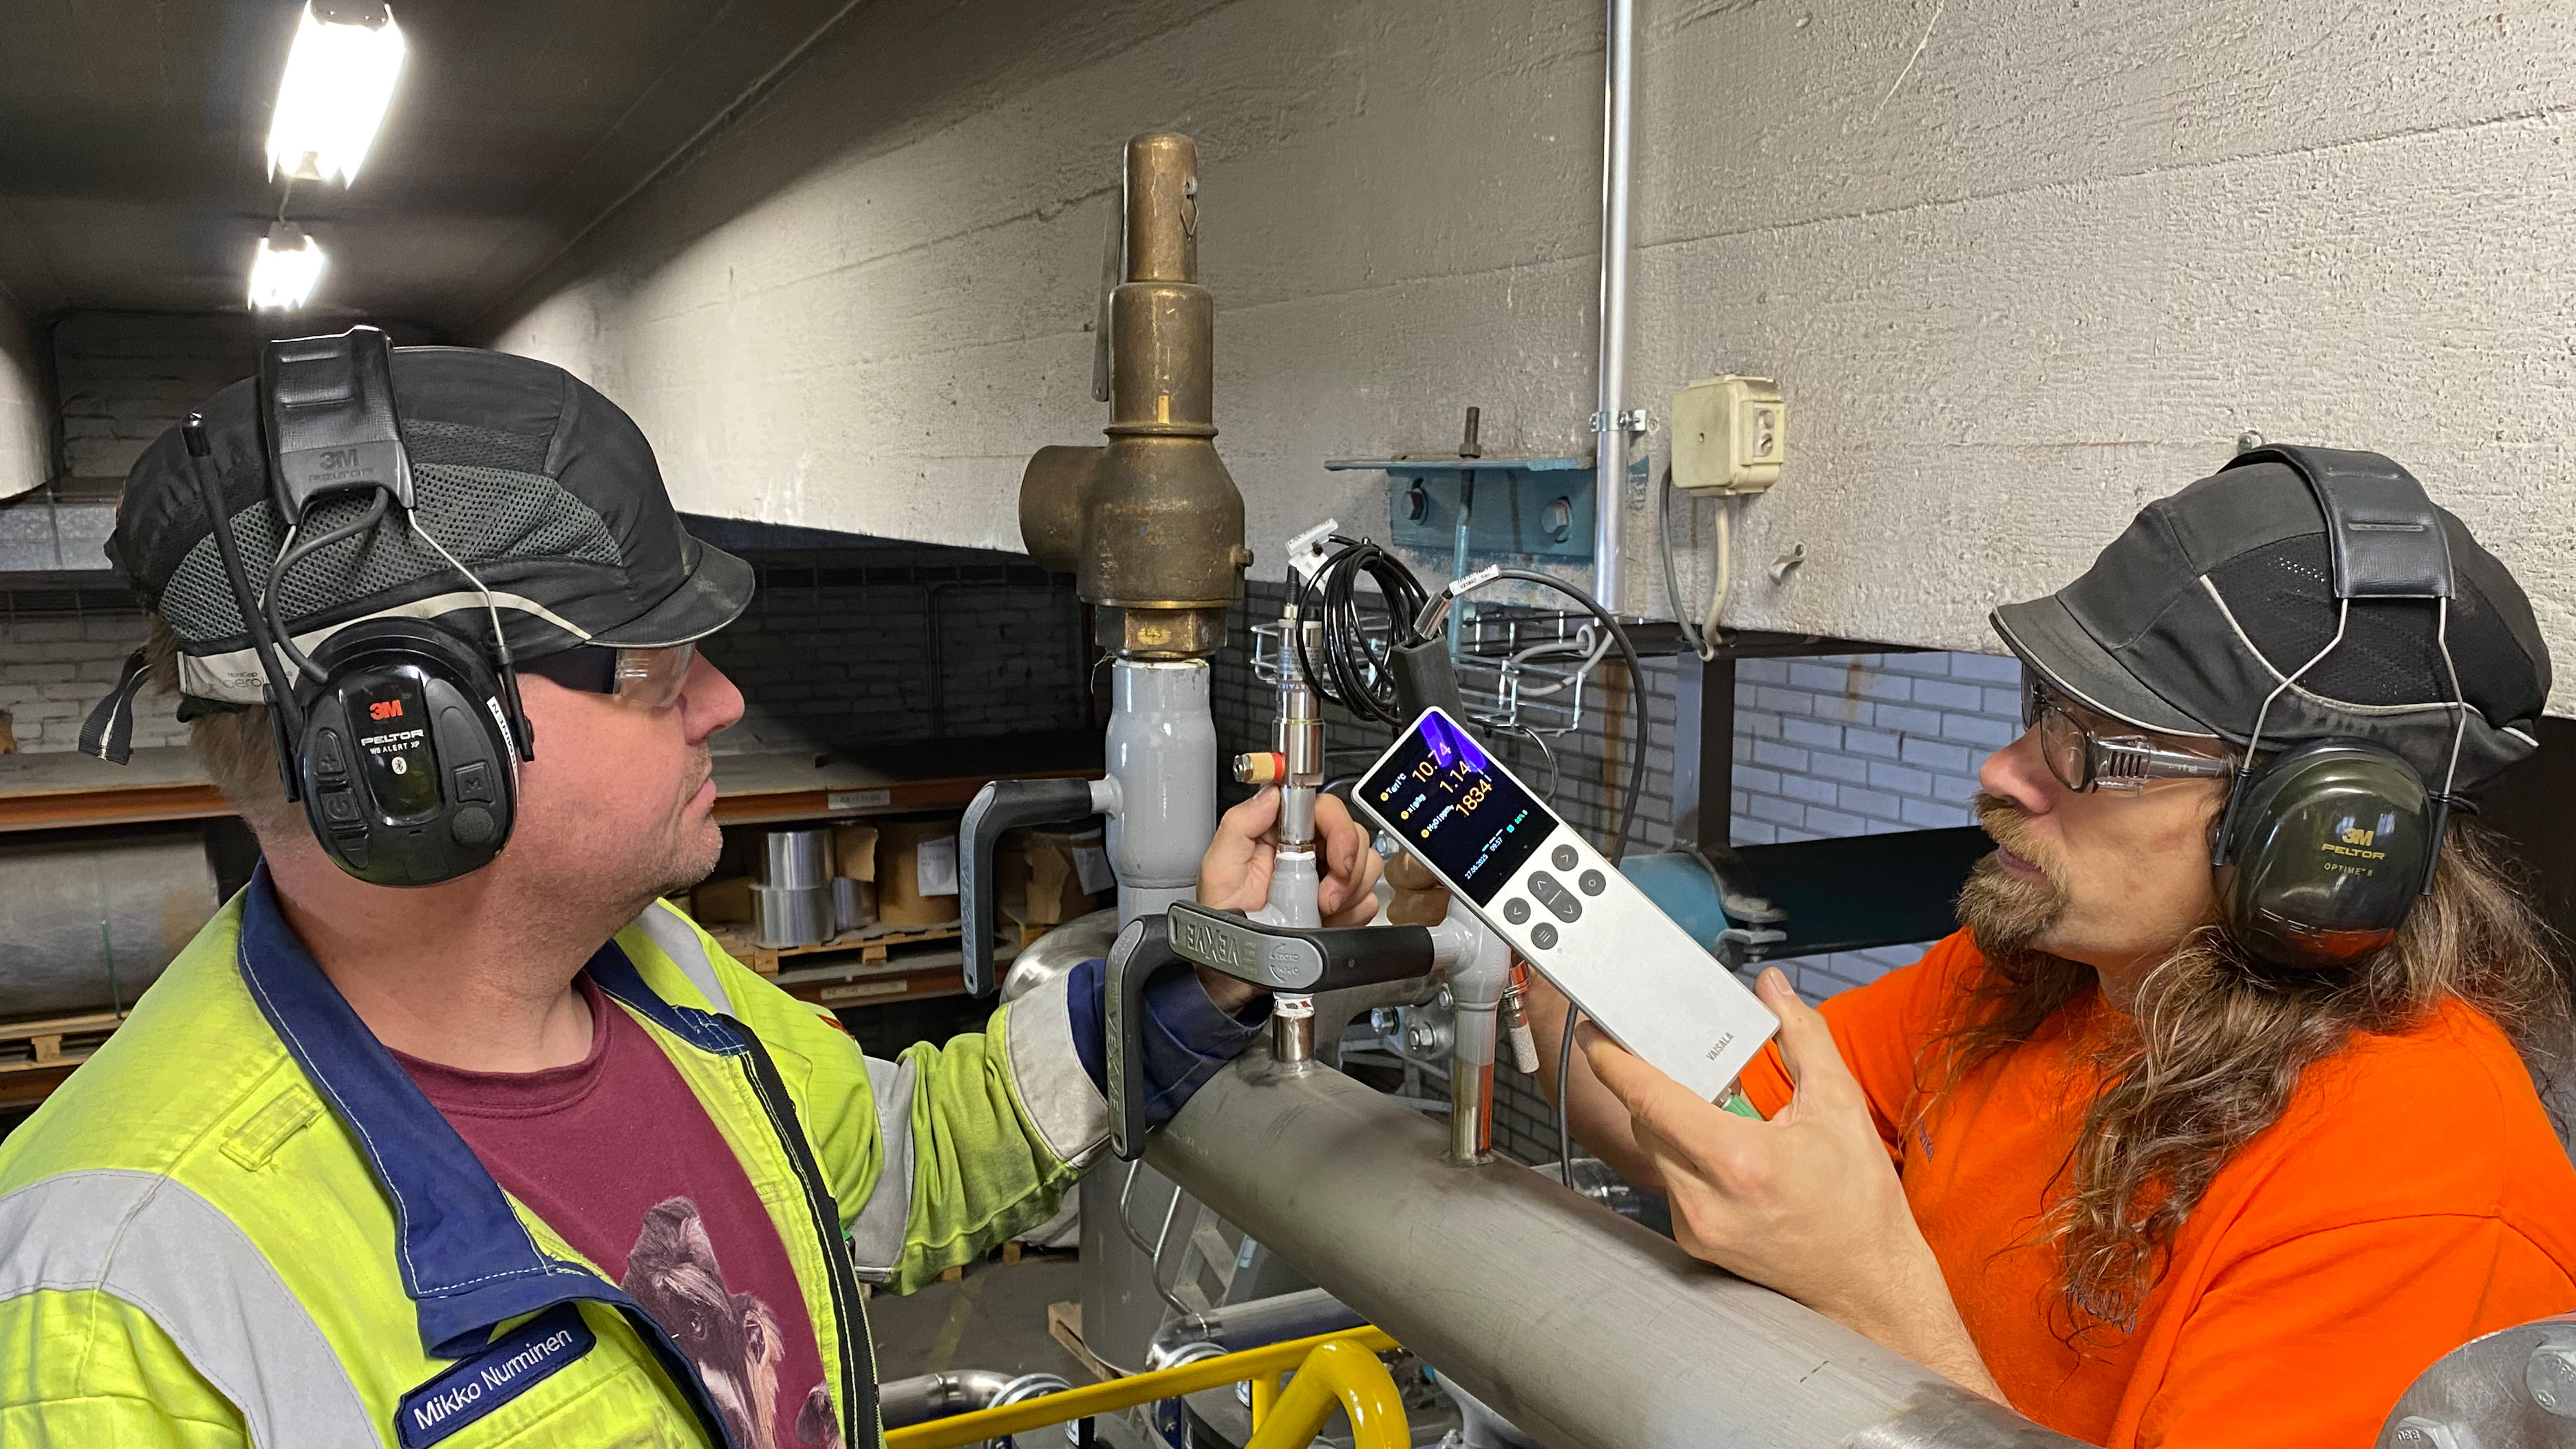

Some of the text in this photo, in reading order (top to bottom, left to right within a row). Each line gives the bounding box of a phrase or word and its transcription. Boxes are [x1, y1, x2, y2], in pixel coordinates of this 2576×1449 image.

[320, 449, 361, 469] 3M
[369, 700, 403, 720] 3M
[361, 729, 425, 747] PELTOR
[383, 742, 407, 753] ALERT
[410, 740, 420, 749] XP
[1412, 742, 1452, 783] 10.74
[1439, 760, 1472, 793] 1.14
[1455, 778, 1493, 817] 1834
[2342, 828, 2374, 846] 3M
[1464, 854, 1489, 880] 27.06.2025
[1490, 837, 1503, 852] 09:57
[2321, 844, 2385, 860] PELTOR
[1186, 923, 1241, 967] VEXVE
[1276, 952, 1300, 962] CLOSE
[1278, 965, 1300, 976] OPEN
[1706, 1032, 1735, 1061] VAISALA
[1107, 1010, 1121, 1112] VEXVE
[414, 1382, 481, 1430] Mikko
